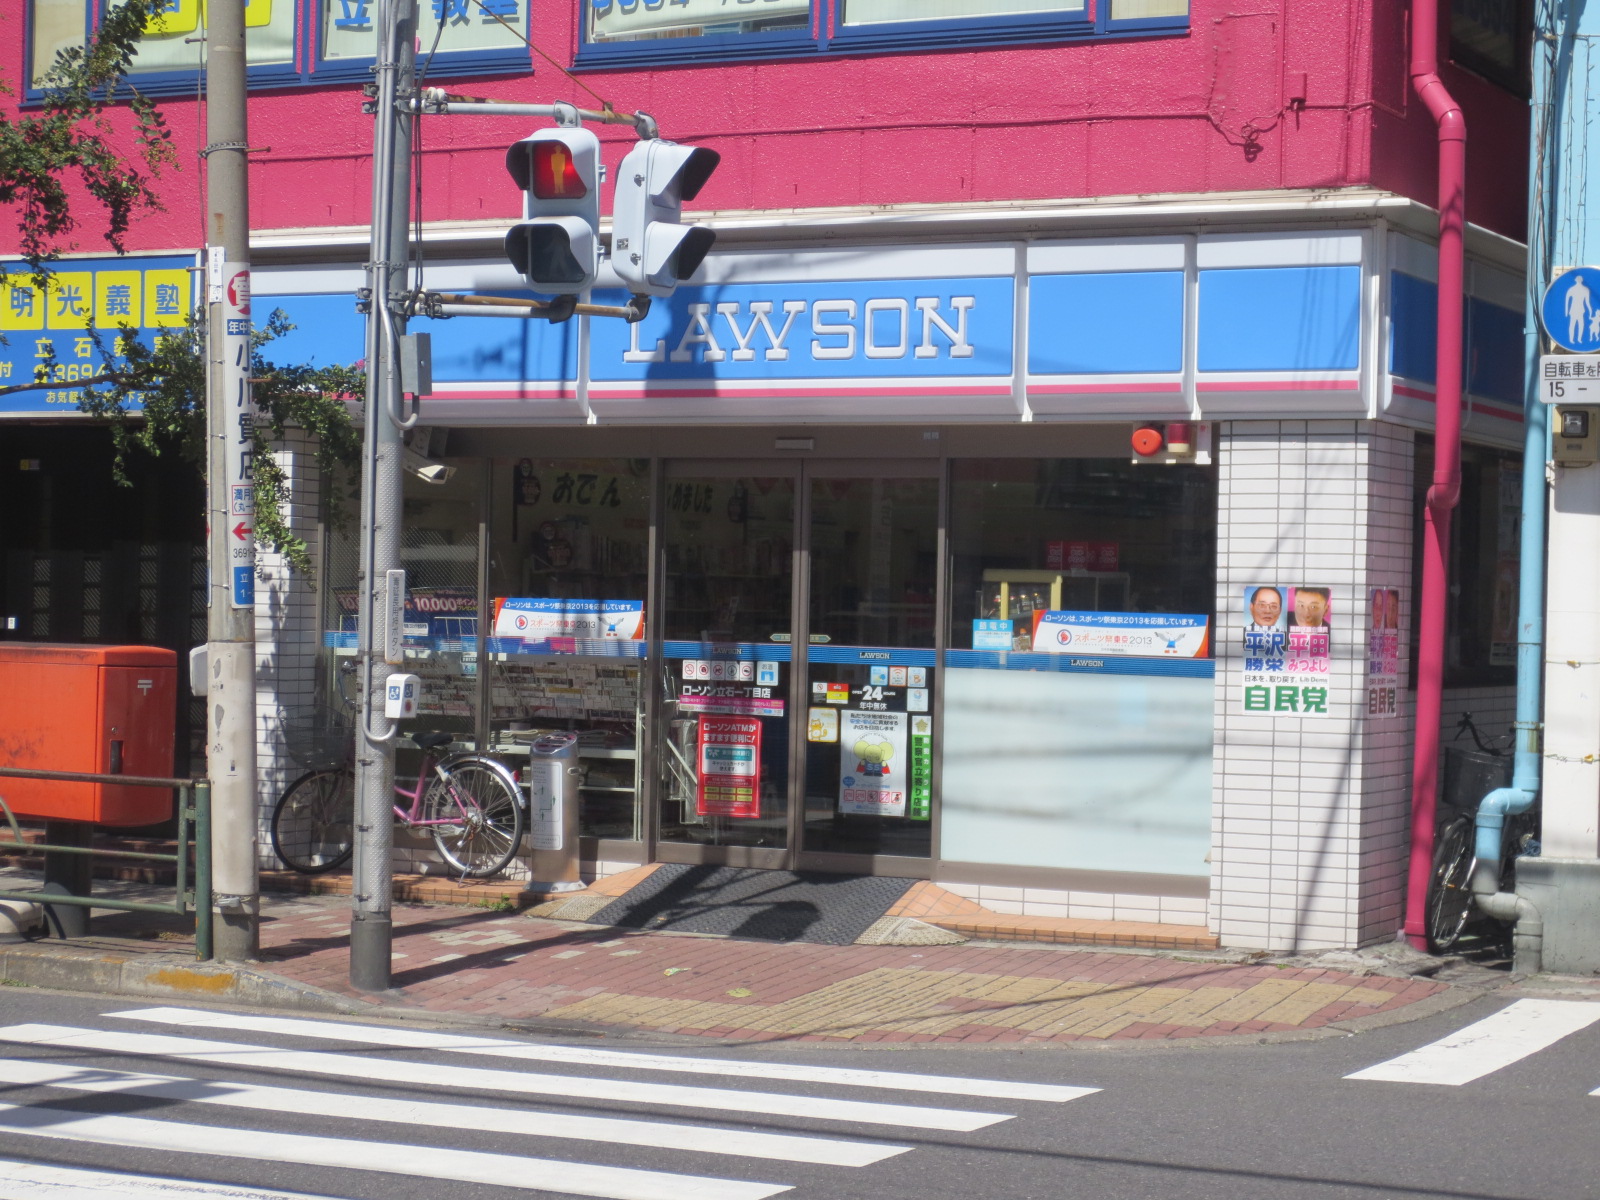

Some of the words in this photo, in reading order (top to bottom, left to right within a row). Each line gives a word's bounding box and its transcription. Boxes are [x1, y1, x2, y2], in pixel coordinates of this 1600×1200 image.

[10, 283, 180, 318] 明光義塾
[623, 296, 976, 365] LAWSON
[1544, 362, 1600, 378] 自転車を
[1549, 381, 1565, 398] 15
[552, 472, 622, 508] おでん
[530, 619, 596, 630] スポーツ祭東京2013
[1074, 633, 1153, 645] スポーツ祭東京2013
[1245, 632, 1286, 657] 平沢
[1288, 633, 1329, 658] 平田
[1070, 659, 1104, 667] LAWSON
[1245, 658, 1284, 672] 勝栄
[1288, 658, 1328, 673] みつよし
[682, 685, 771, 698] ローソン立石一丁目店
[862, 685, 883, 701] 24
[1244, 685, 1328, 713] 自民党
[859, 702, 888, 710] 年中無休
[1369, 688, 1396, 715] 自民党
[703, 722, 757, 732] ローソンATMが
